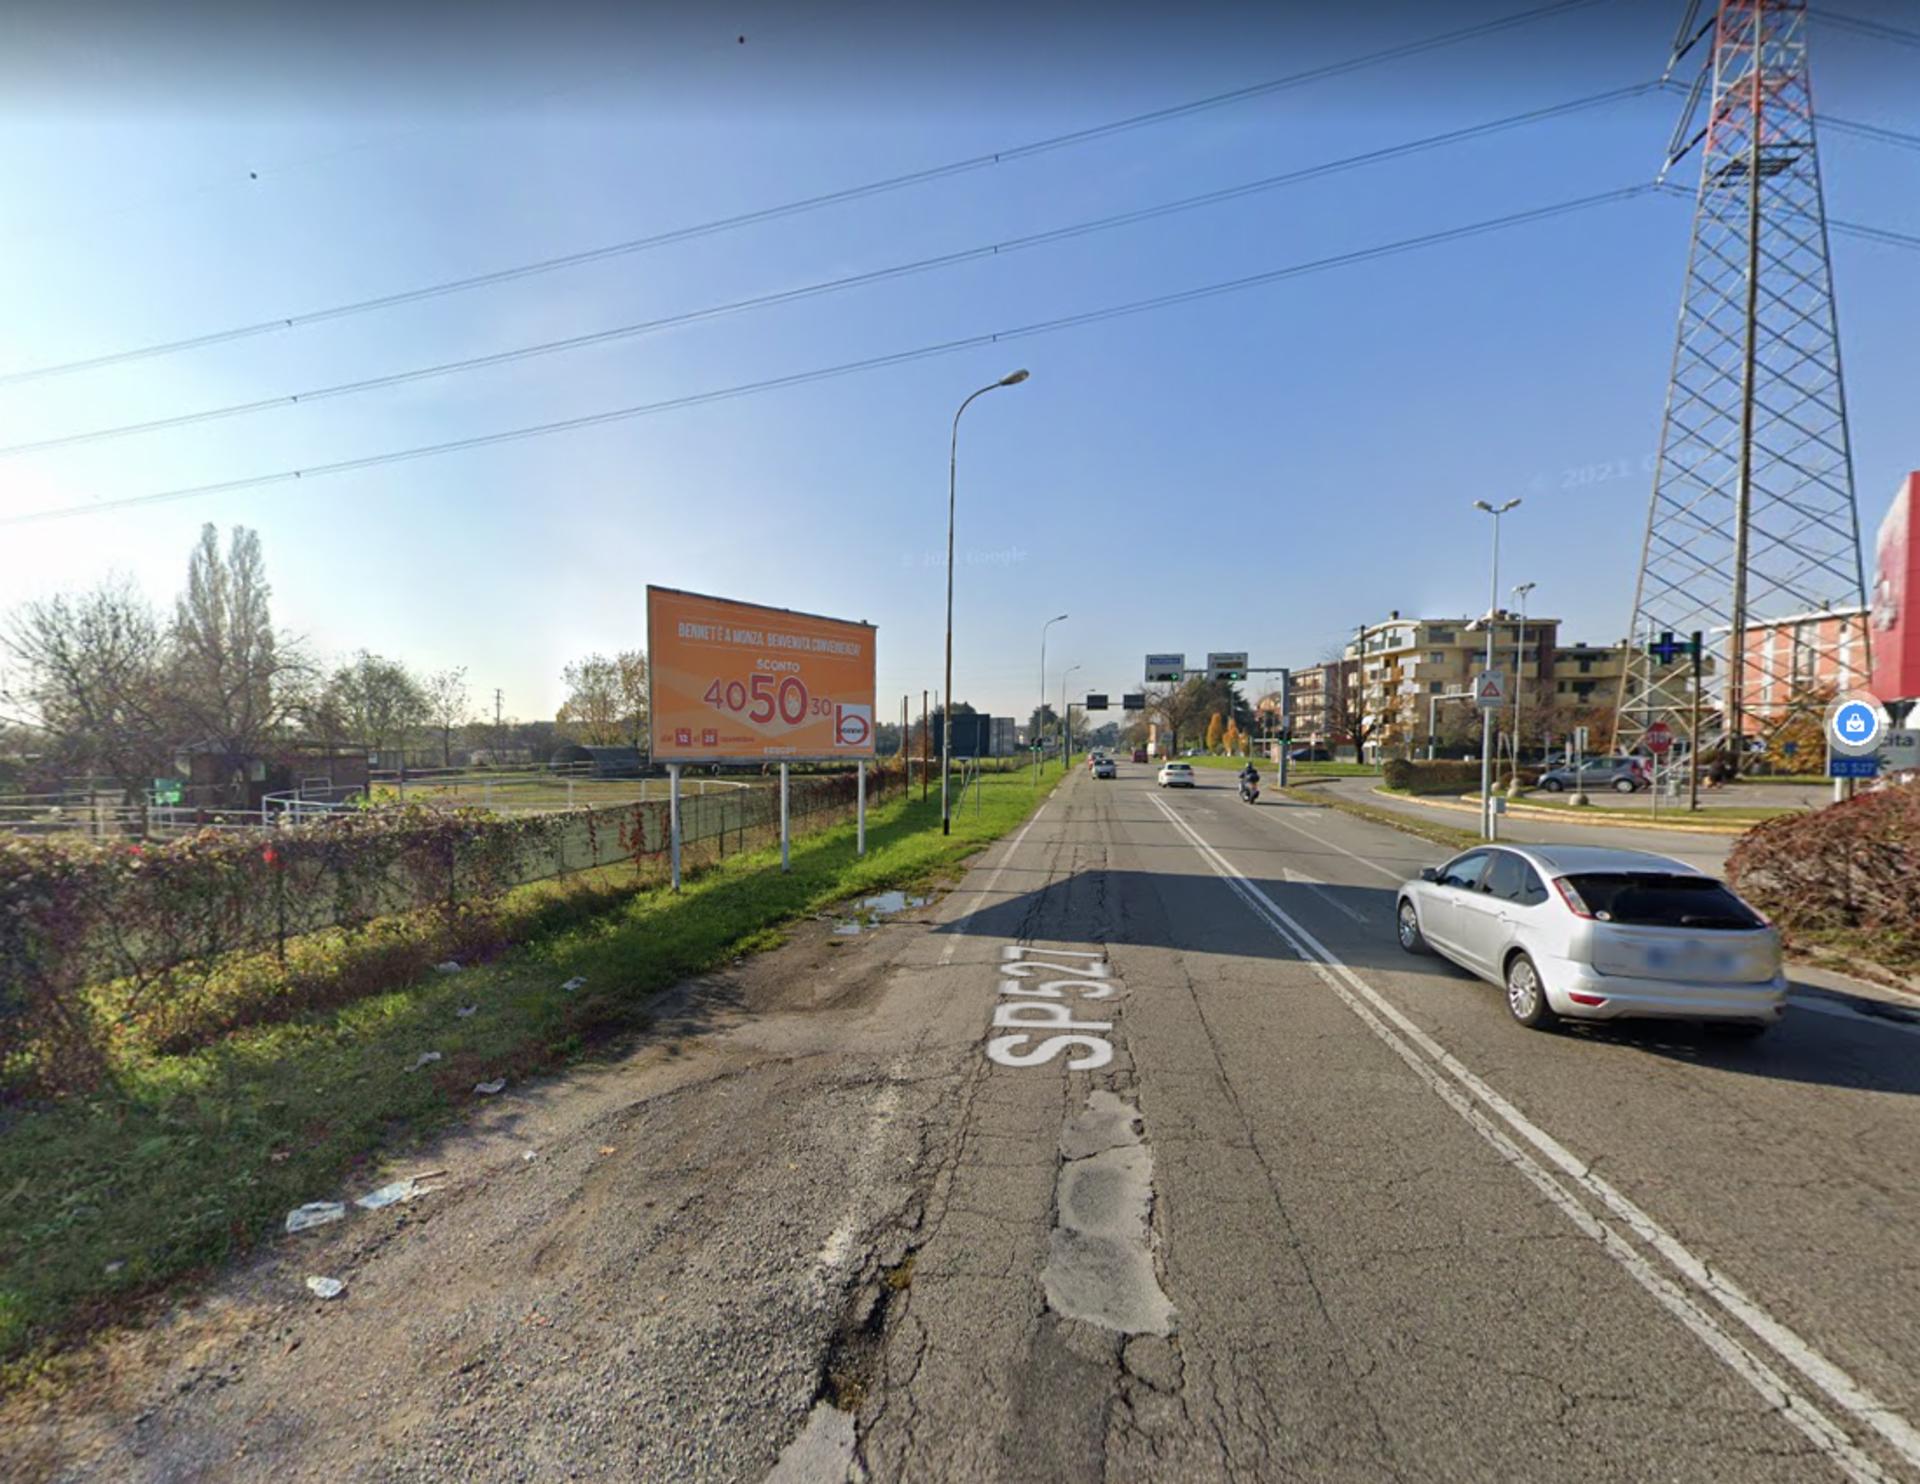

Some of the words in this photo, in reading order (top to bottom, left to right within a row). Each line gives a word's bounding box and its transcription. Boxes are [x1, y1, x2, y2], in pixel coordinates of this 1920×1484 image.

[756, 658, 800, 673] SCONTO
[703, 678, 746, 712] 40
[811, 697, 832, 716] 30
